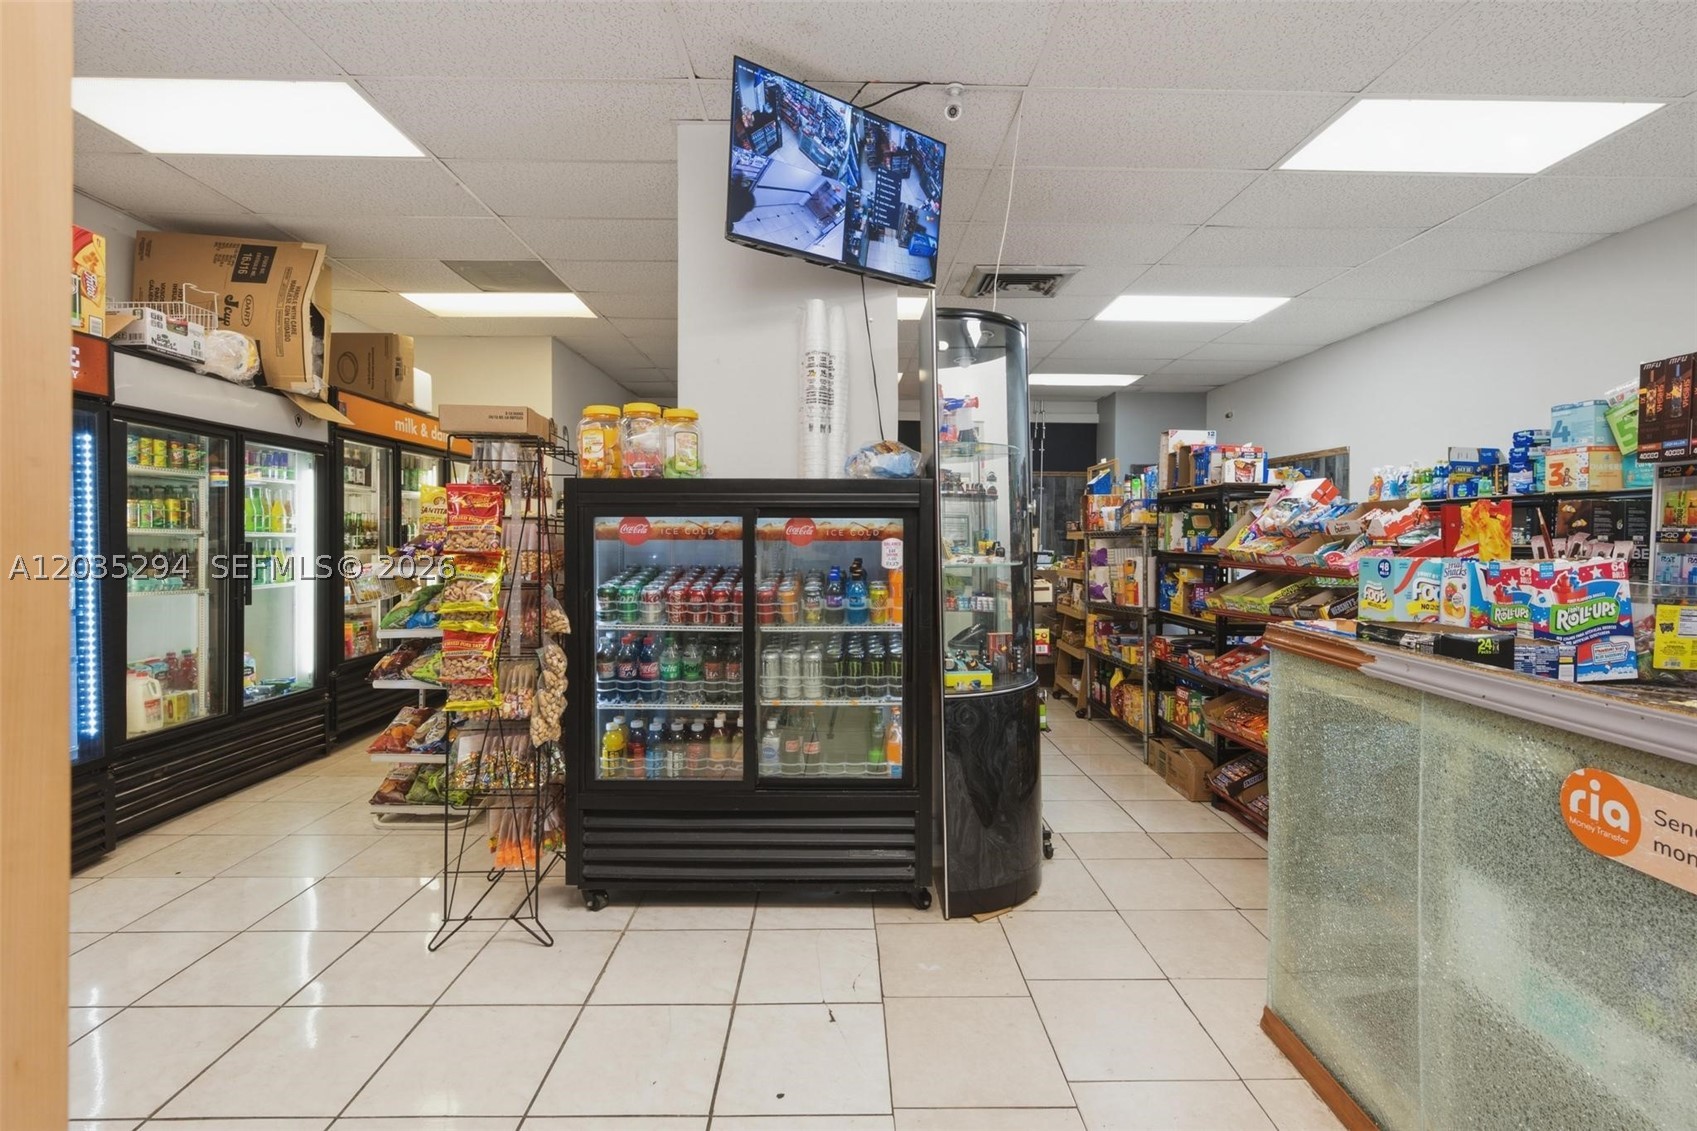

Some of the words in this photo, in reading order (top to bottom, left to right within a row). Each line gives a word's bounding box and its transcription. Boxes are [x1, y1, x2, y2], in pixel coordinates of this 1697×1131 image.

[237, 253, 253, 275] 16J16
[244, 298, 252, 324] DART
[394, 418, 418, 436] milk
[420, 423, 429, 438] &
[1552, 420, 1571, 443] 4
[1549, 462, 1564, 486] 3
[661, 528, 679, 536] ICE
[684, 528, 715, 536] COLD
[826, 529, 844, 537] ICE
[850, 529, 880, 537] COLD
[1379, 562, 1390, 571] 48
[1519, 567, 1532, 577] 64
[1611, 561, 1625, 571] 64
[1477, 638, 1492, 650] 24
[1569, 779, 1630, 833] ria
[1569, 816, 1596, 834] Money
[1597, 826, 1630, 846] Transfer
[1654, 809, 1697, 838] Sen
